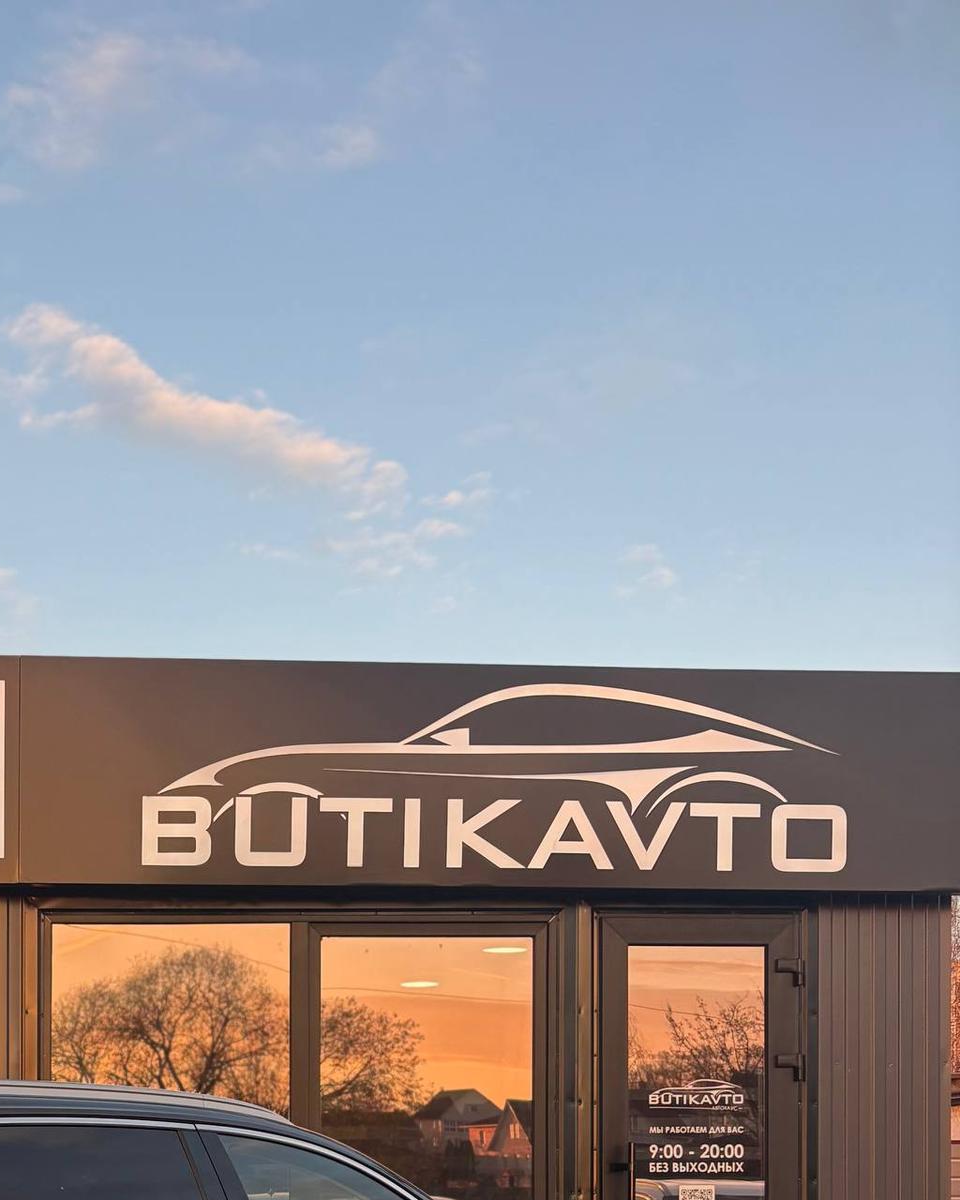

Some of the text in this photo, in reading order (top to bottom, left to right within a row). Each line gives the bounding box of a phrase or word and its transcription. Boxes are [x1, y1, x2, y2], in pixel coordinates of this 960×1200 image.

[141, 794, 848, 873] BUTIKAVTO
[648, 1094, 745, 1105] BUTIKAVTO
[649, 1126, 745, 1135] МЫ РАБОТАЕМ ДЛЯ ВАС
[649, 1144, 683, 1159] 9:00
[700, 1144, 745, 1159] 20:00
[649, 1162, 745, 1174] БЕЗ ВЫХОДНЫХ
